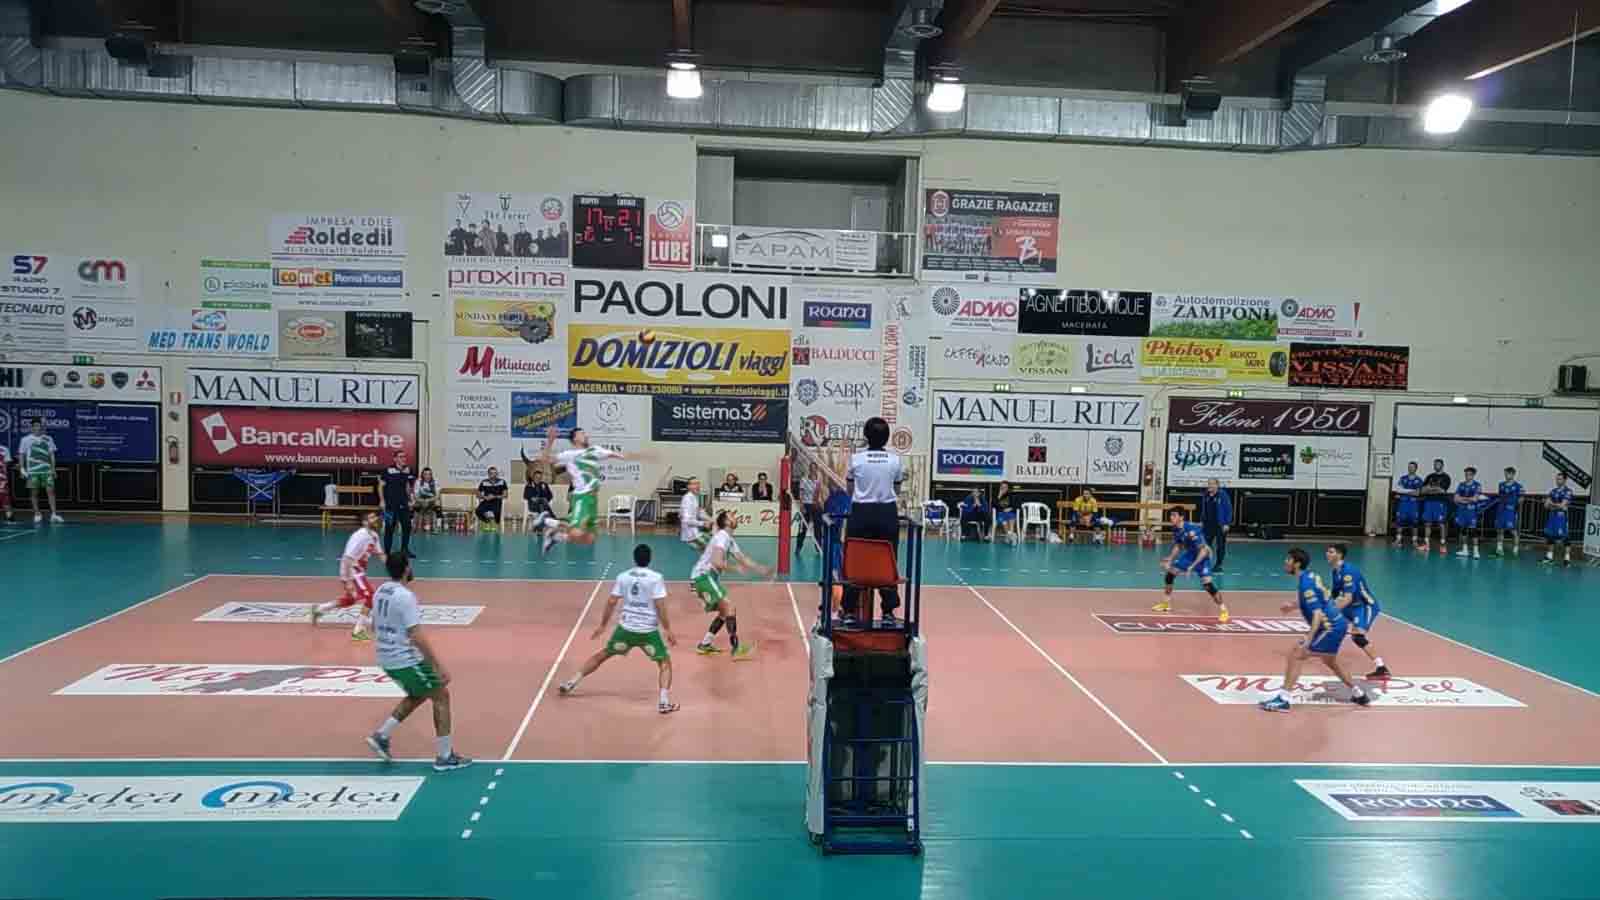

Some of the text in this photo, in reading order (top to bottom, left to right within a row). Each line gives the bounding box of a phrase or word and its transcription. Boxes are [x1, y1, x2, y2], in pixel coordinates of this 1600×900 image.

[952, 198, 994, 210] GRAZIE
[306, 215, 392, 226] IMPRESA EDILE
[286, 226, 392, 246] Roldedil
[651, 239, 690, 262] LUBE
[735, 241, 832, 259] FAPAM
[13, 255, 49, 275] S7
[448, 265, 565, 289] proxima
[1, 285, 61, 295] STUDIO 7
[574, 279, 788, 320] PAOLONI
[1175, 295, 1271, 307] Autodemolizione
[808, 306, 867, 319] Roana
[958, 300, 1017, 317] ADMO
[1172, 304, 1270, 321] ZAMPONI
[1297, 307, 1336, 319] ADMO
[1061, 321, 1108, 329] MACERATA
[148, 331, 272, 351] MED TRANS WORLD
[572, 337, 788, 377] DOMIZIOLI viaggi
[811, 347, 875, 361] BALDUCCI
[192, 374, 416, 406] MANUEL RITZ
[570, 383, 618, 393] MACERATA
[937, 396, 1141, 427] MANUEL RITZ
[1178, 401, 1361, 430] Filoni 1950
[240, 425, 404, 449] BancaMarche
[264, 452, 379, 465] www.bancamarche.it
[942, 453, 999, 466] Roana
[1092, 459, 1133, 473] SABRY
[1172, 448, 1228, 472] sport
[1015, 464, 1080, 477] BALDUCCI
[226, 784, 402, 805] medea
